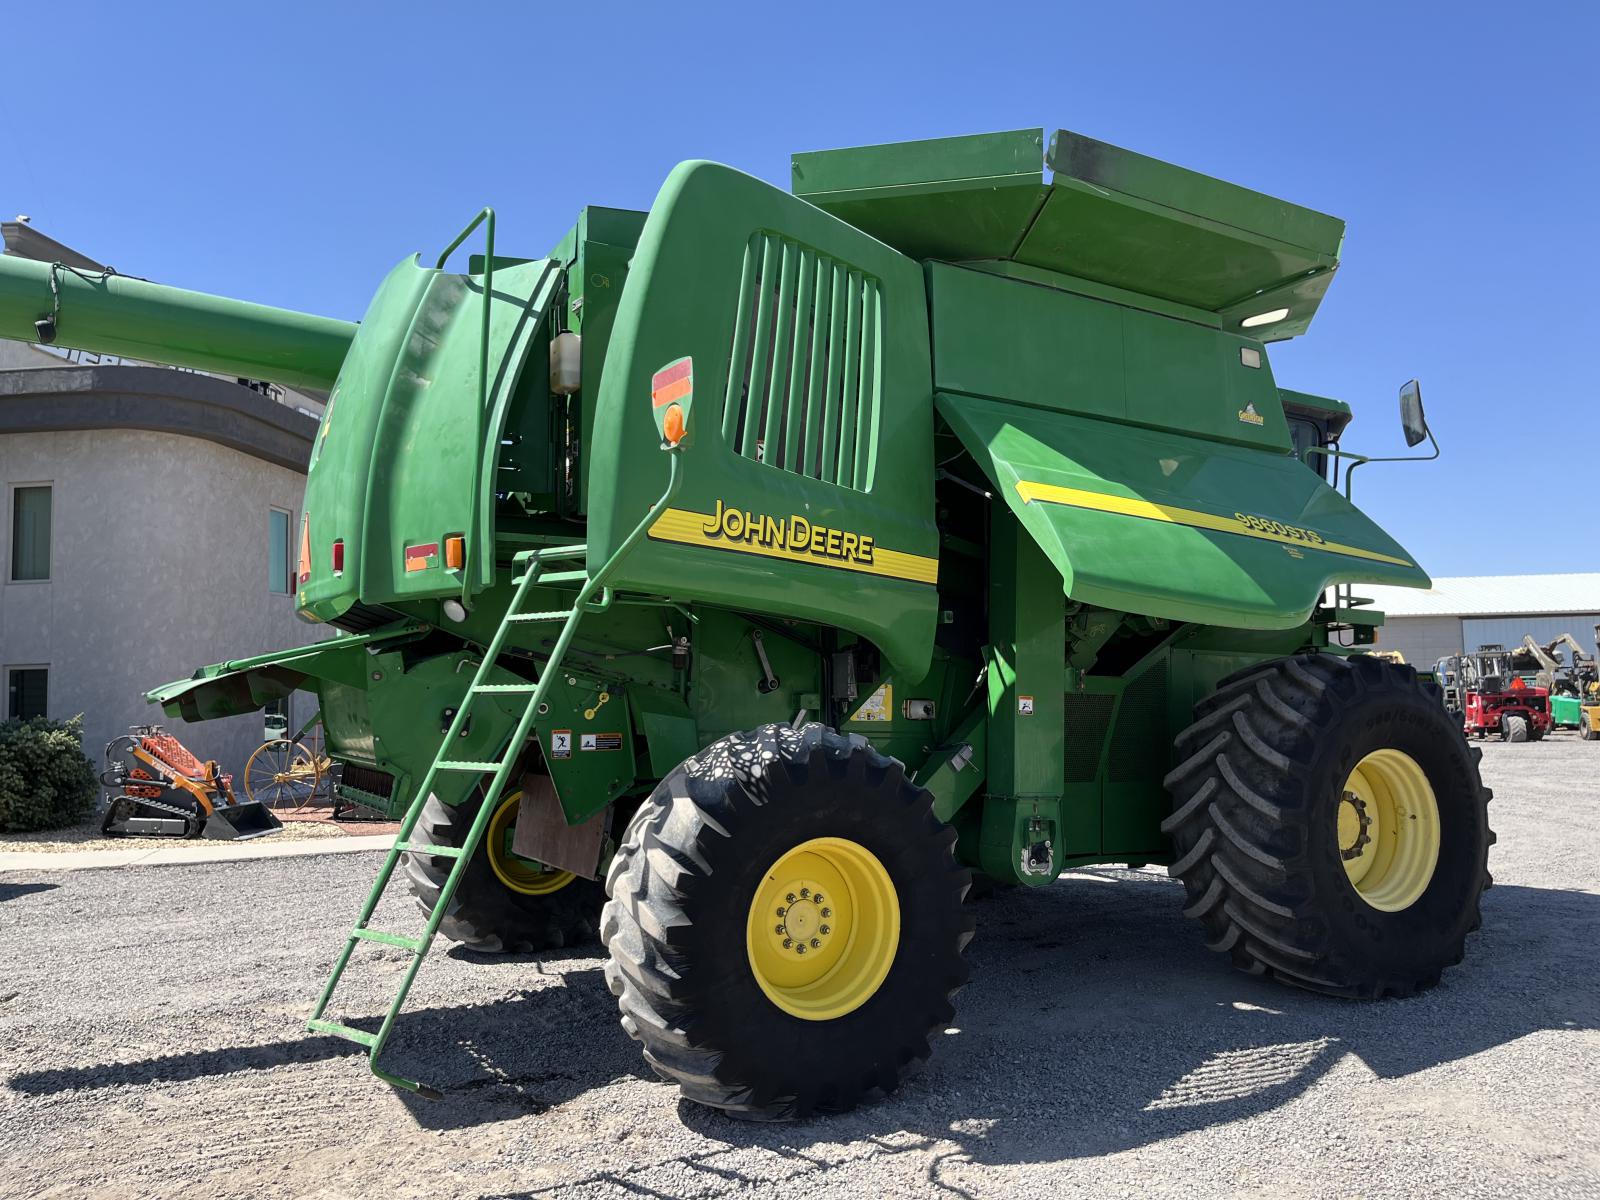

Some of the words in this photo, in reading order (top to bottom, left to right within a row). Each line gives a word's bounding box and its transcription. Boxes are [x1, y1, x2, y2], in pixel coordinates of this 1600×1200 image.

[702, 499, 786, 549] JOHN
[788, 514, 873, 565] DEERE
[1234, 512, 1325, 544] 9860STS
